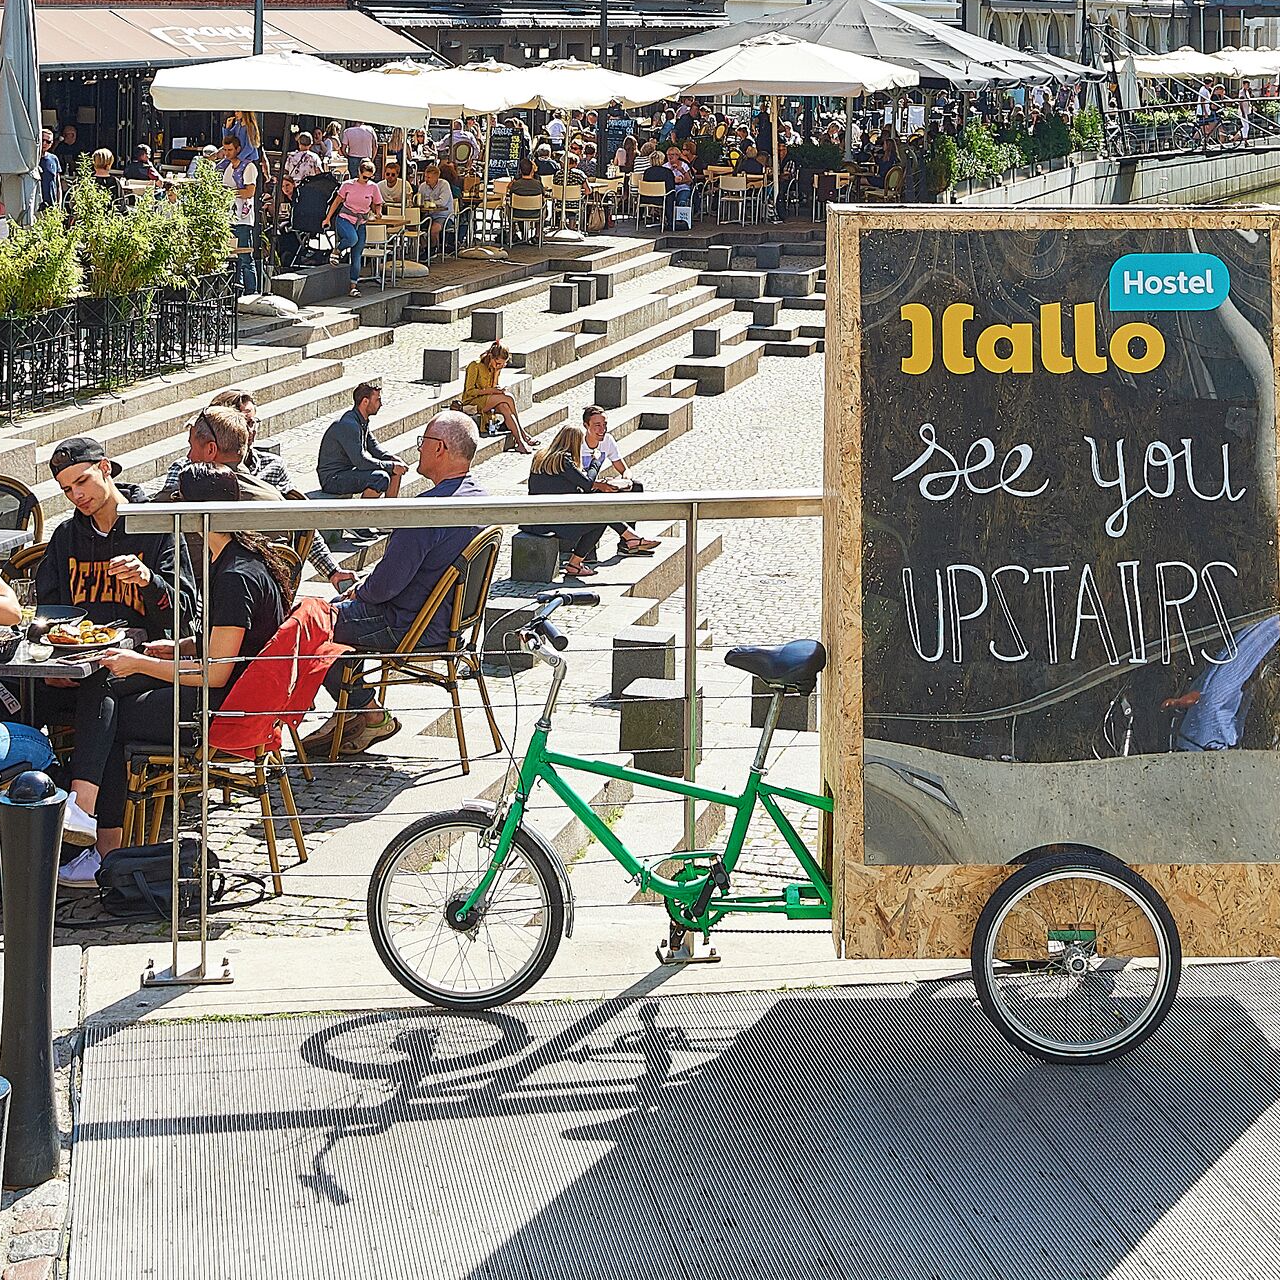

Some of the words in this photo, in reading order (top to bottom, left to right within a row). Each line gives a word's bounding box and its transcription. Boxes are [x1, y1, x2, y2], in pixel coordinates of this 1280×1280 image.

[1123, 268, 1214, 295] Hostel
[900, 302, 1166, 375] Hallo
[892, 422, 1051, 502] see
[1083, 434, 1247, 539] you
[901, 559, 1239, 666] UPSTAIRS
